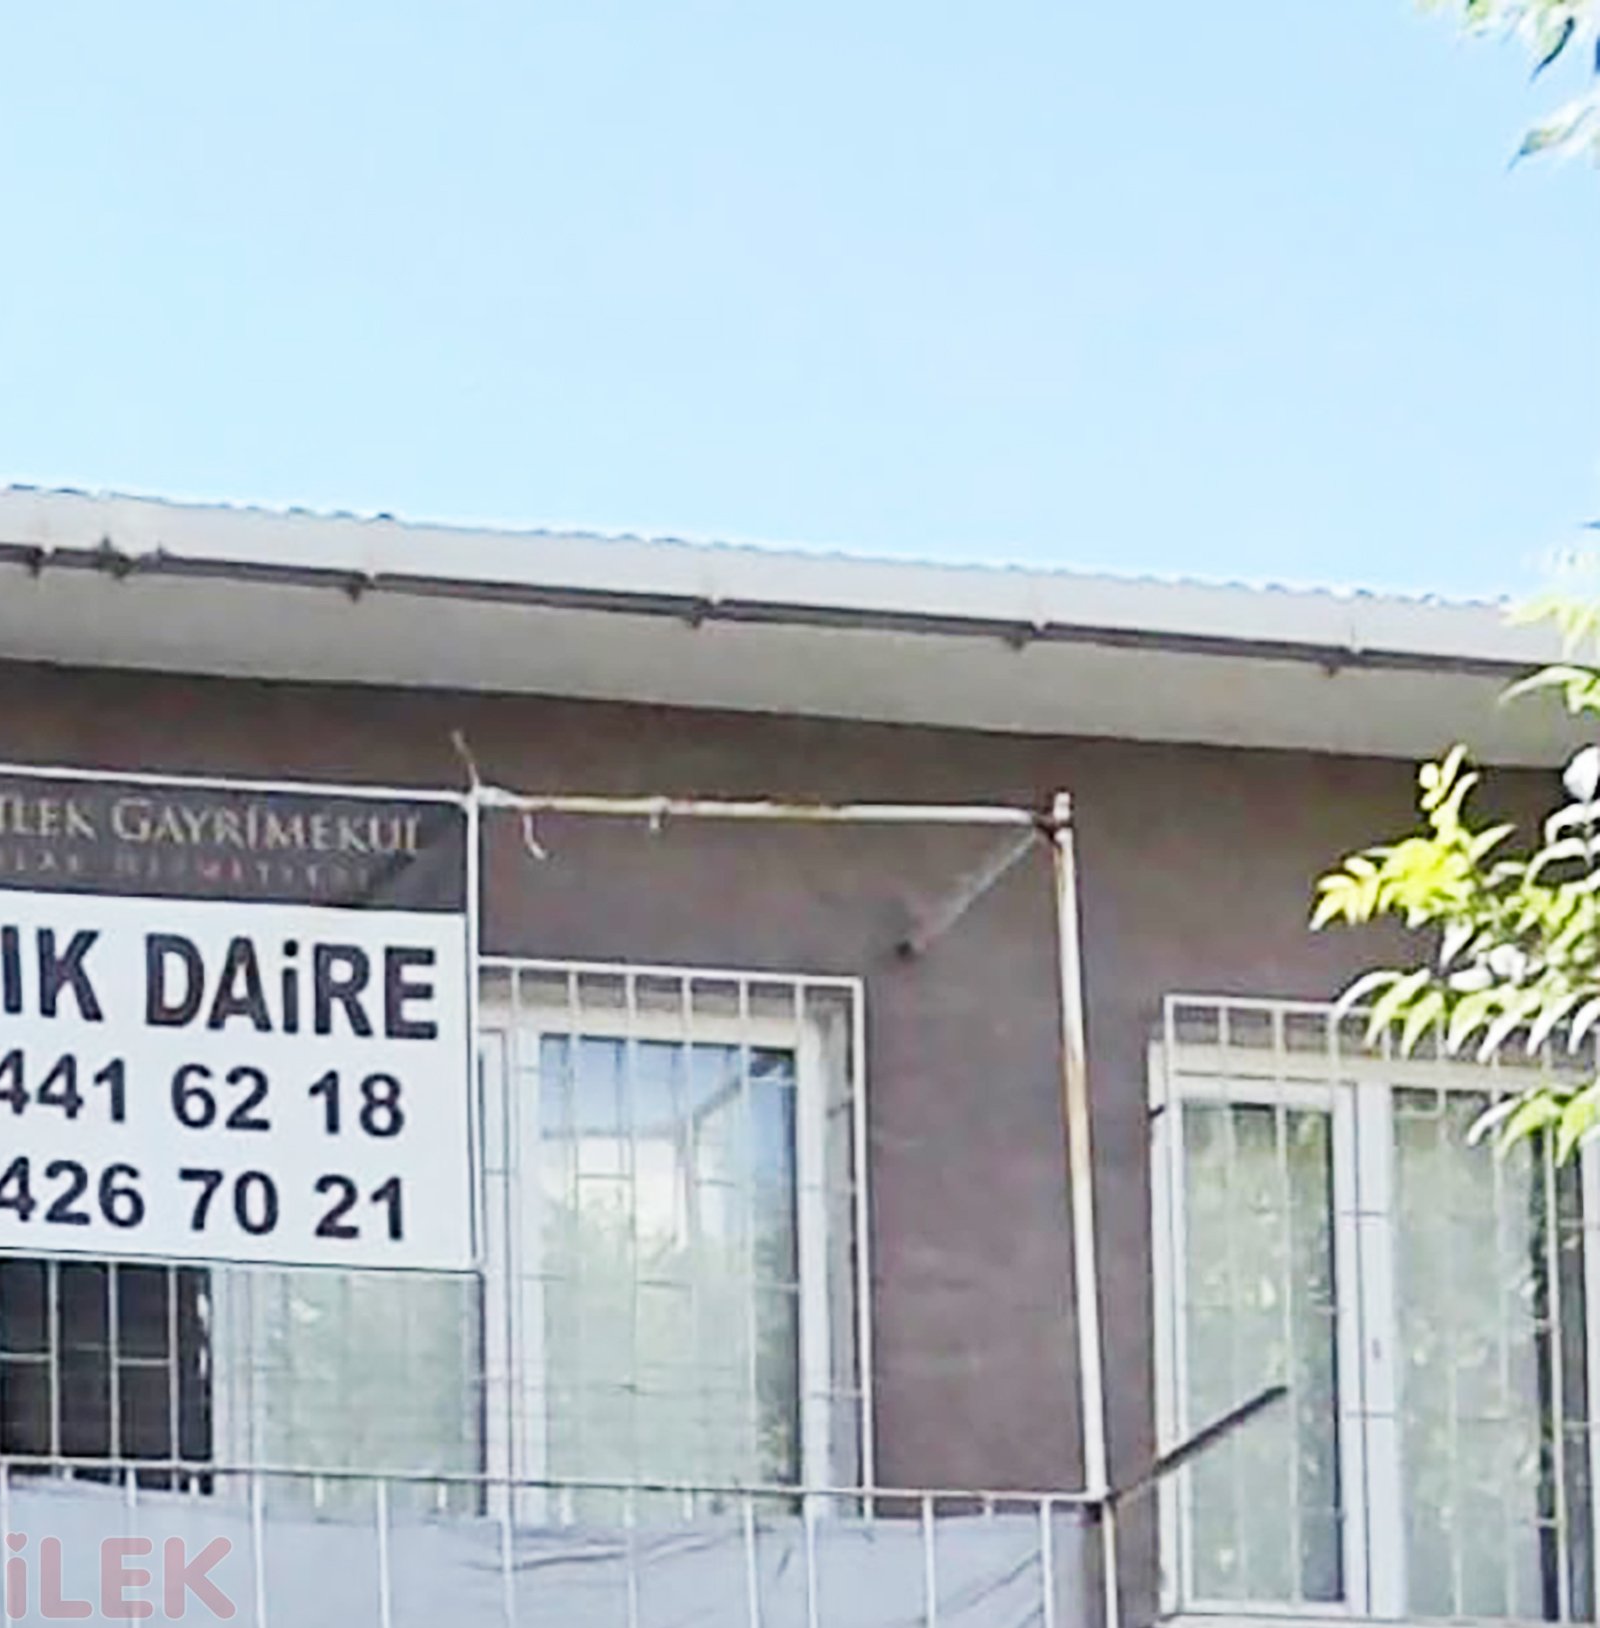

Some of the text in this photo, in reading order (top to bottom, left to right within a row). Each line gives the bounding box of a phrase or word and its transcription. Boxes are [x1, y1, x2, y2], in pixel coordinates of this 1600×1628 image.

[171, 1064, 270, 1133] 62
[308, 1070, 405, 1138] 18
[177, 1168, 280, 1237] 70
[314, 1174, 404, 1241] 21
